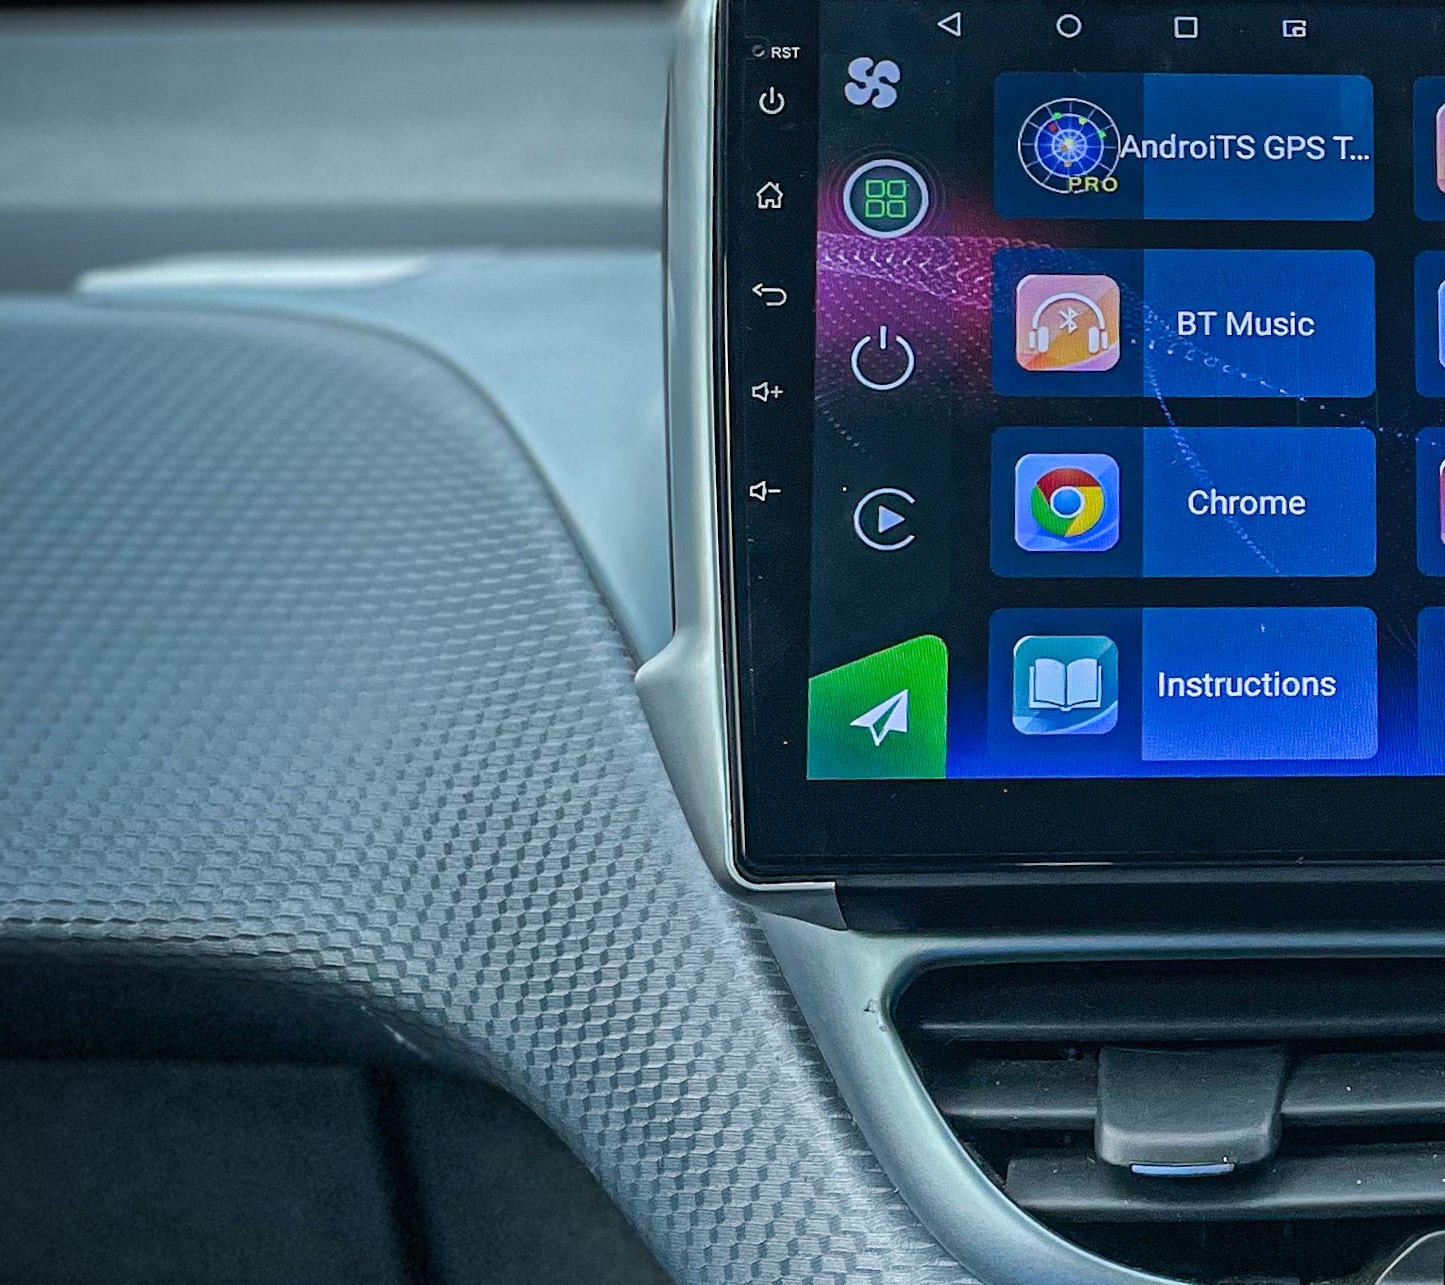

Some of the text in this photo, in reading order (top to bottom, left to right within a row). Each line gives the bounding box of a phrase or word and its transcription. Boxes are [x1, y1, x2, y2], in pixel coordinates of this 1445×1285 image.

[769, 46, 801, 59] RST
[1119, 133, 1256, 160] AndroiTS
[1263, 134, 1326, 160] GPS
[1068, 176, 1118, 193] PRO
[1177, 311, 1316, 338] BT Music
[1187, 488, 1307, 517] Chrome
[1157, 670, 1338, 699] Instructions
